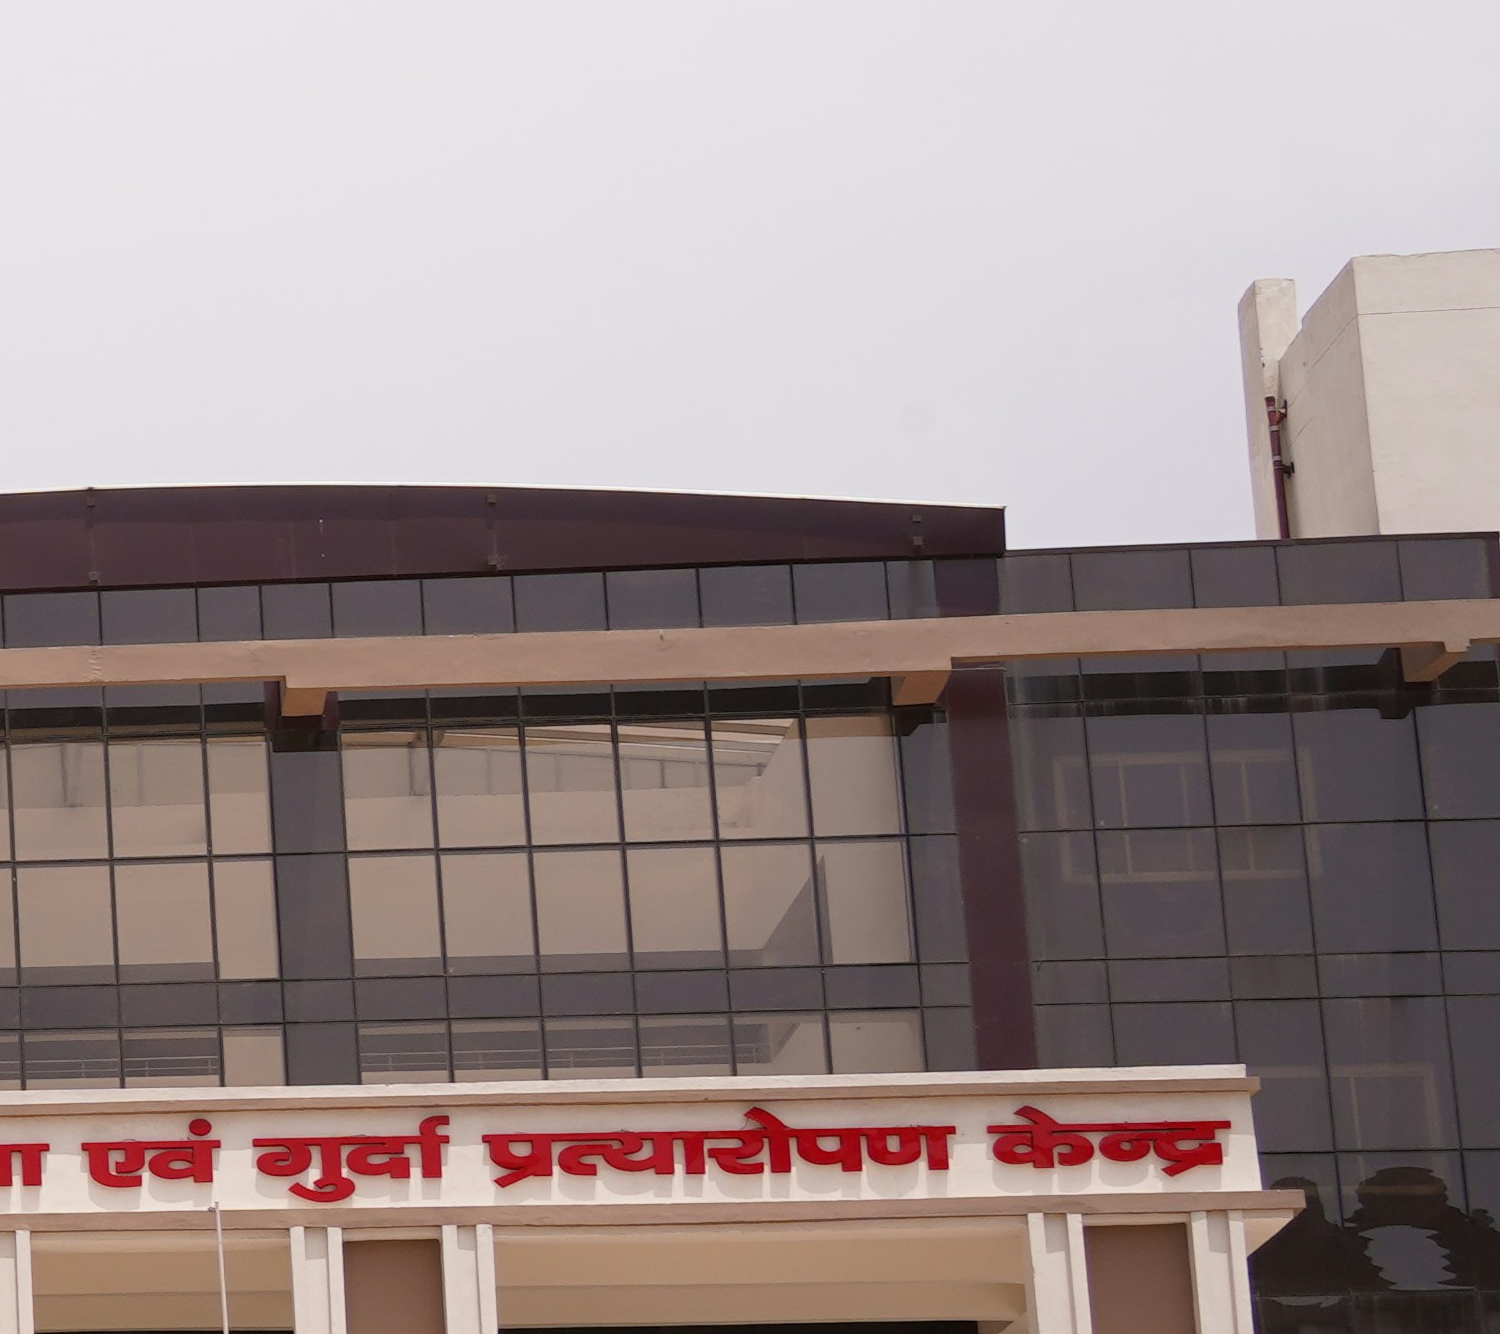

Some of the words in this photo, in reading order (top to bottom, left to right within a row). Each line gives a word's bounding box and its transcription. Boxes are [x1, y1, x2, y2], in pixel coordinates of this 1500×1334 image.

[81, 1119, 221, 1188] एवं
[252, 1116, 450, 1203] गुर्दा
[482, 1107, 956, 1188] प्रत्यारोपण
[987, 1107, 1232, 1177] केन्द्र
